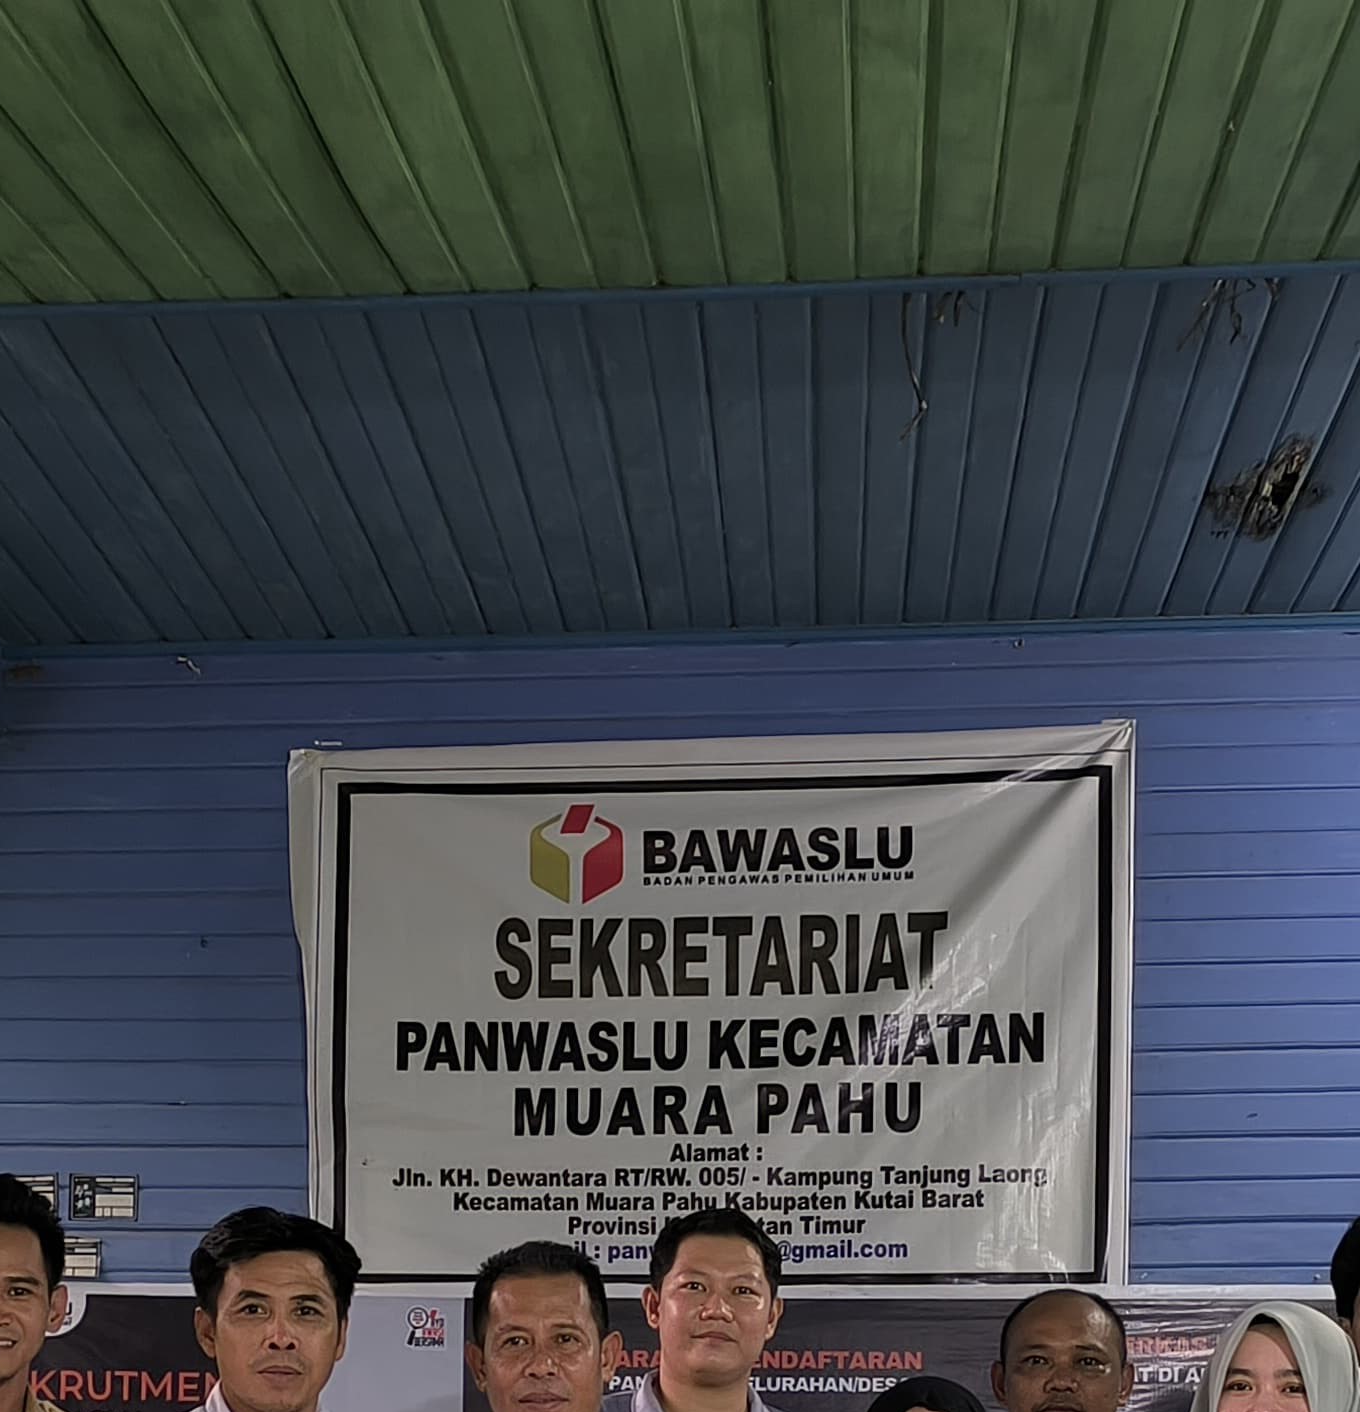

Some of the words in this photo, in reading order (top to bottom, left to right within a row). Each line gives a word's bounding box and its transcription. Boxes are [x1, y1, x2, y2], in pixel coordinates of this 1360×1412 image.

[643, 825, 913, 874] BAWASLU
[643, 875, 692, 886] BADAN
[698, 874, 779, 885] PENGAWAS
[785, 871, 867, 883] PEMILIHAN
[871, 870, 914, 881] UMUM
[494, 911, 948, 1000] SEKRETARIAT
[396, 1020, 688, 1072] PANWASLU
[709, 1012, 1045, 1069] KECAMATAN
[513, 1085, 733, 1136] MUARA
[757, 1082, 921, 1134] PAHU
[670, 1143, 749, 1161] Alamat
[392, 1168, 432, 1187] Jln.
[440, 1168, 479, 1187] KH.
[487, 1168, 607, 1187] Dewantara
[614, 1167, 691, 1187] RT/RW.
[698, 1166, 746, 1187] 005/
[766, 1167, 873, 1189] Kampung
[880, 1165, 971, 1188] Tanjung
[978, 1164, 1048, 1187] Laong
[453, 1192, 579, 1211] Kecamatan
[586, 1192, 655, 1211] Muara
[662, 1192, 718, 1211] Pahu
[725, 1191, 846, 1214] Kabupaten
[854, 1190, 914, 1210] Kutai
[921, 1189, 984, 1208] Barat
[568, 1216, 656, 1235] Provinsi
[800, 1215, 866, 1234] Timur
[752, 1351, 922, 1370] NDAFTARAN
[31, 1370, 220, 1401] KRUTME
